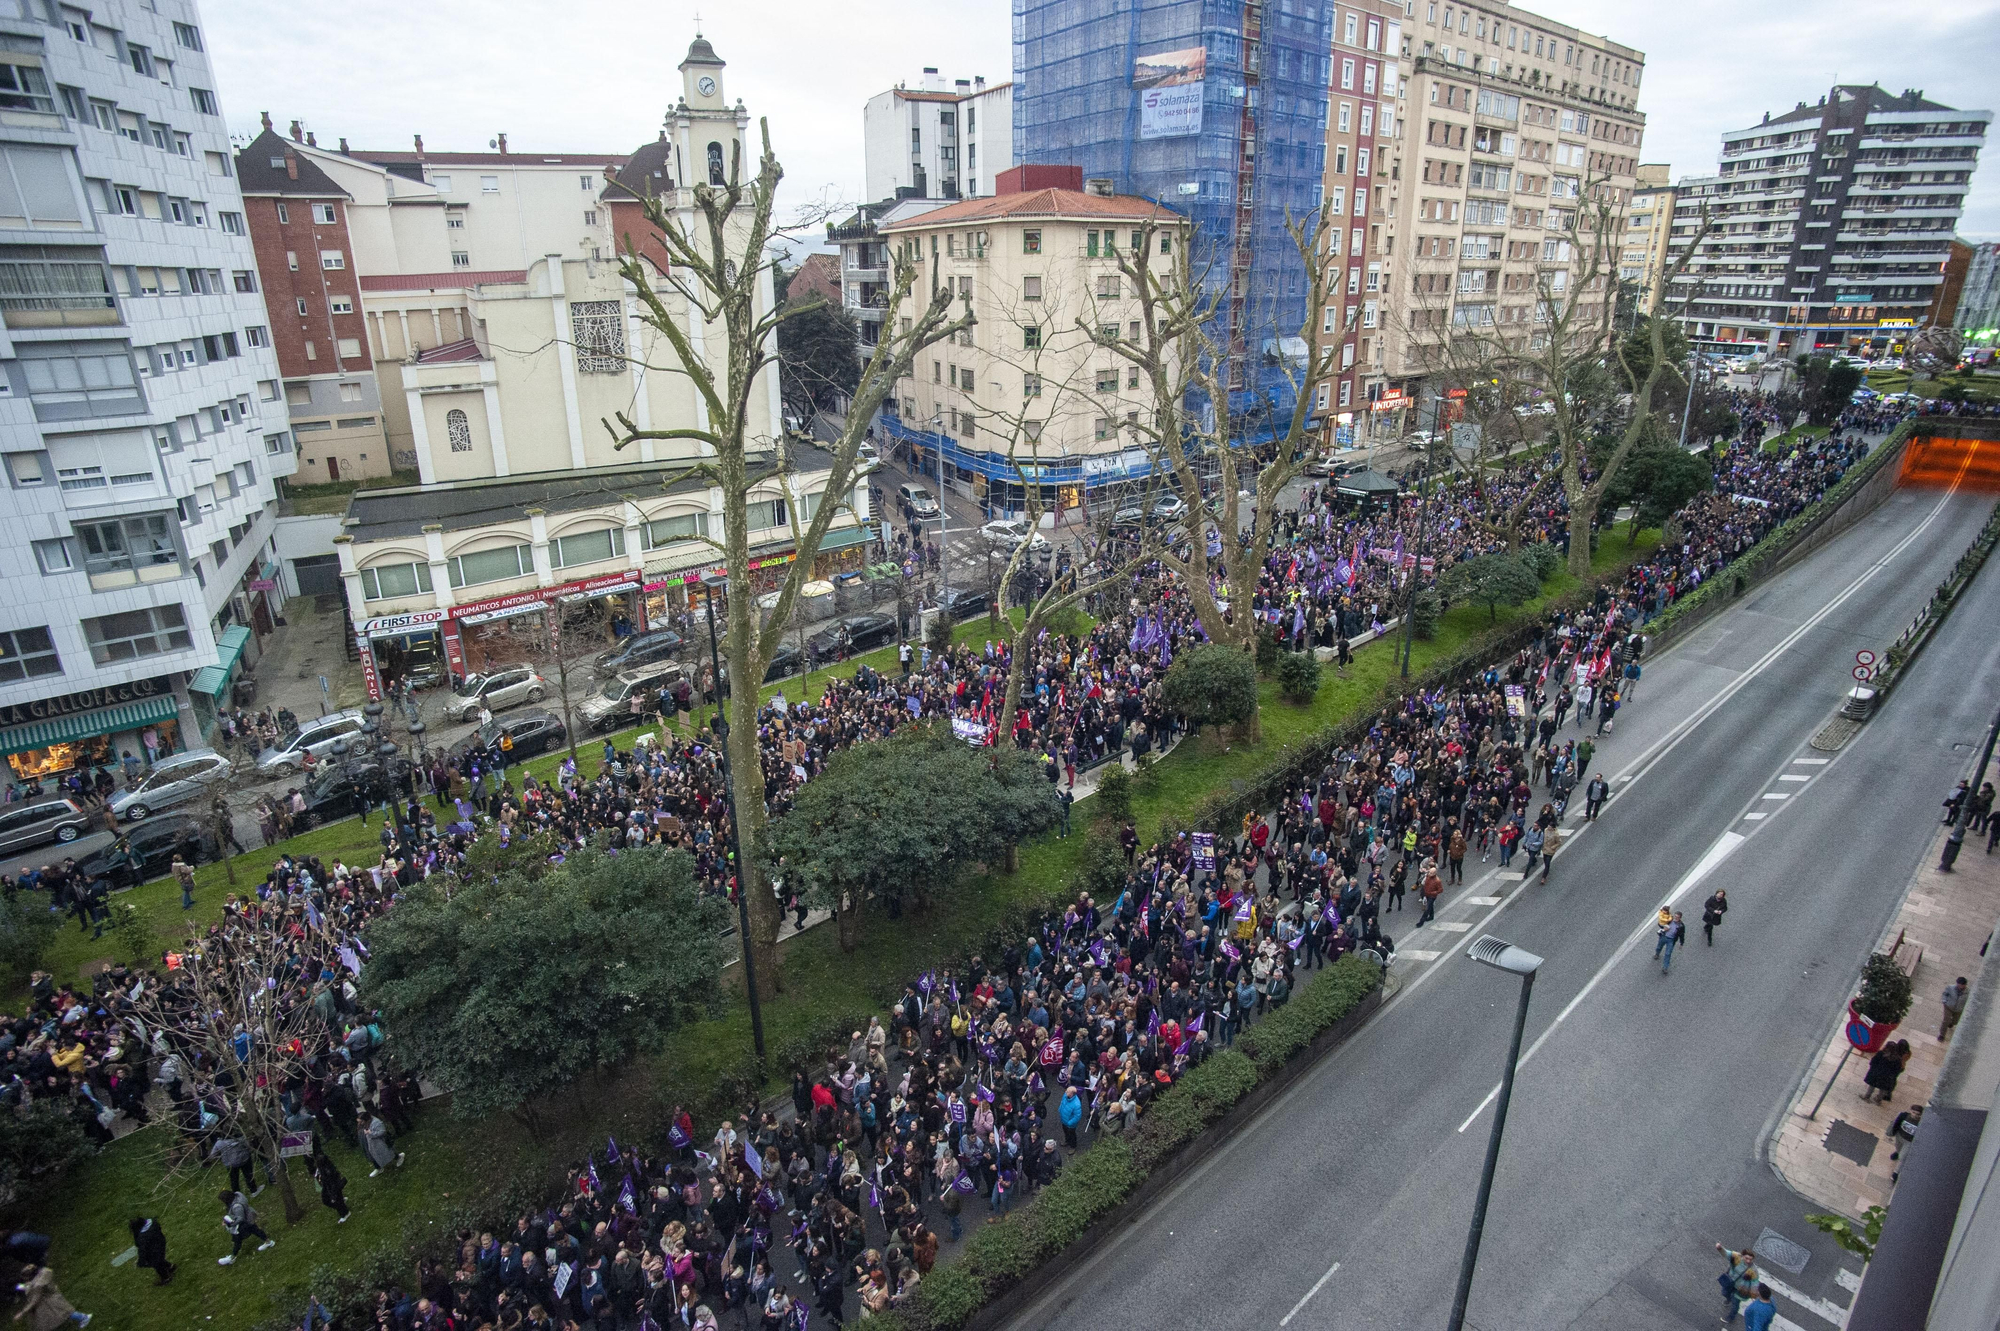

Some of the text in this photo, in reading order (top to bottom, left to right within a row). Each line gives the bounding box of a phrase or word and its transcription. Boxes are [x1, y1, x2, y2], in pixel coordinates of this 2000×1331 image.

[1159, 93, 1200, 107] solamaza
[453, 601, 500, 617] NEUMÁTICOS
[501, 594, 535, 607] ANTONIO
[585, 576, 623, 589] Alineaciones
[381, 612, 442, 628] FIRST STOP
[0, 709, 24, 725] LA
[30, 689, 118, 717] GALLOFA
[119, 688, 132, 700] &
